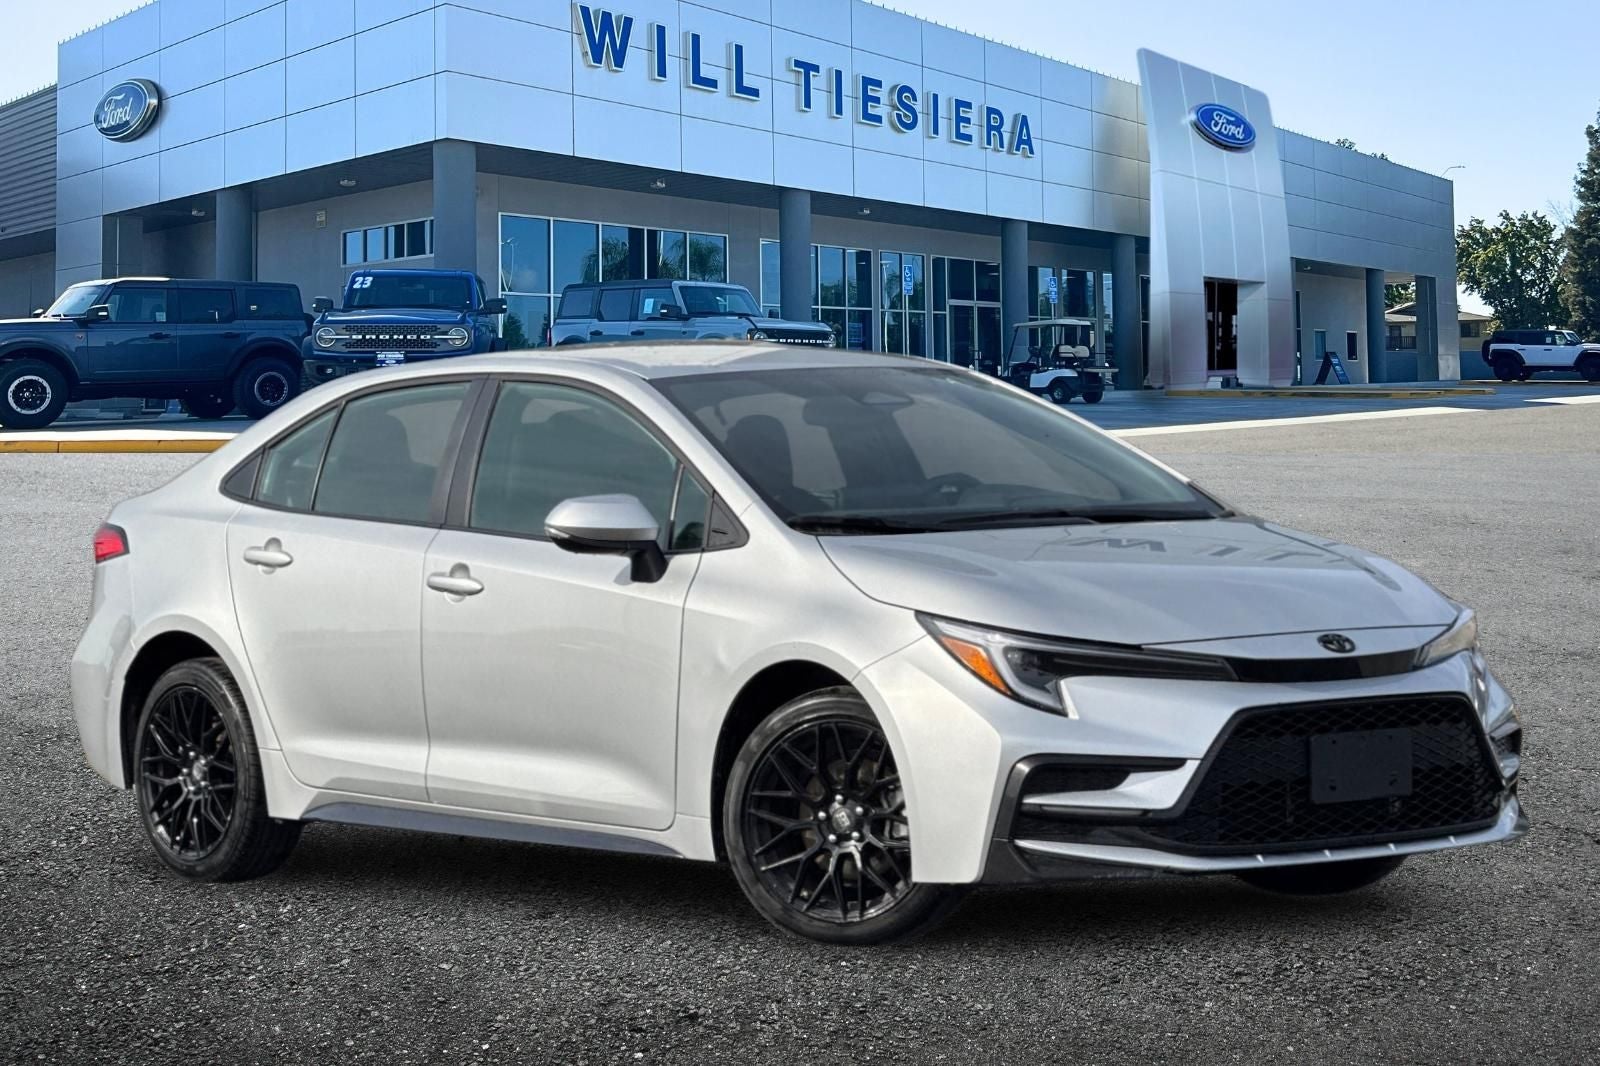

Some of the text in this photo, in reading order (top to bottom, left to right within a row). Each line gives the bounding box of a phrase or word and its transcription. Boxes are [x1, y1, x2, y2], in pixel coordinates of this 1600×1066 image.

[575, 4, 1035, 157] WILL TIESIERA
[101, 93, 133, 128] Ford
[1211, 111, 1245, 139] Ford
[352, 276, 373, 289] 23
